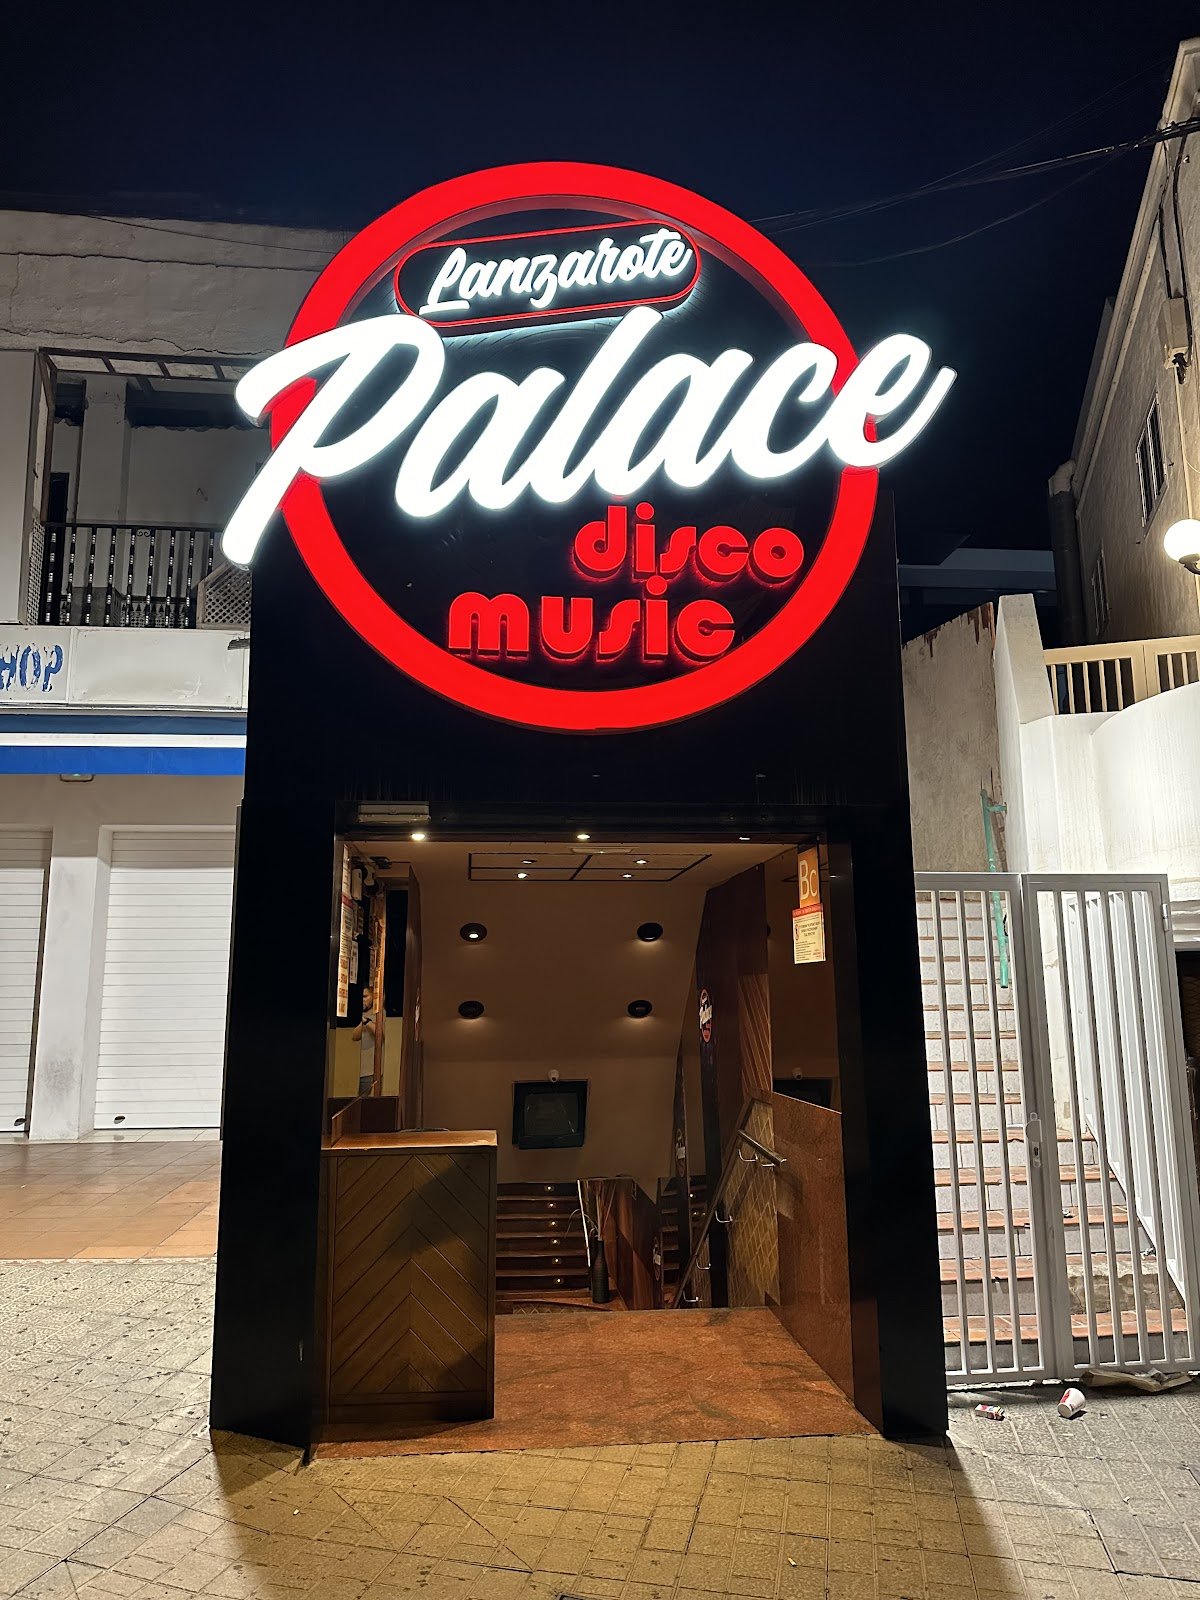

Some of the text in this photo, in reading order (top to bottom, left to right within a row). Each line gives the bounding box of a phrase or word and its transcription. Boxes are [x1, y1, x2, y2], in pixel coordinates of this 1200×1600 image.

[418, 228, 693, 316] Lanzarote
[219, 305, 957, 570] Palace
[573, 501, 805, 579] disco
[447, 574, 736, 657] music
